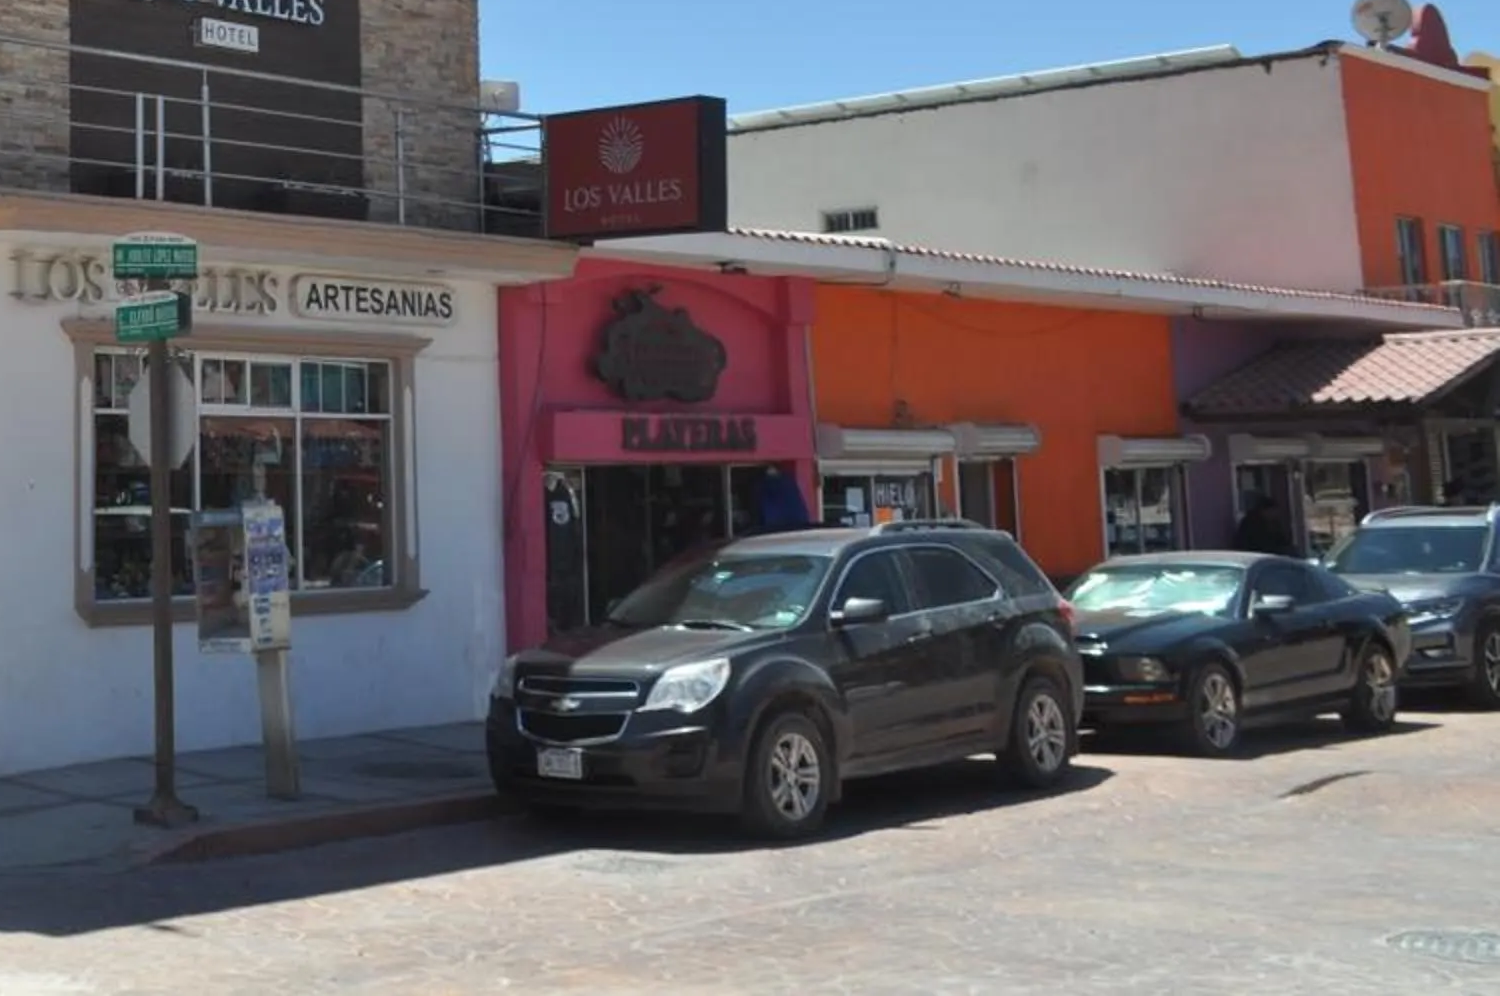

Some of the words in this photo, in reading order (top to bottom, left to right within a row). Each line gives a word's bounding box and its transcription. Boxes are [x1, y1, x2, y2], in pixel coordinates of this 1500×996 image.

[204, 24, 258, 48] HOTEL
[563, 186, 601, 213] LOS
[608, 178, 682, 205] VALLES
[8, 248, 105, 303] LOS
[306, 283, 453, 319] ARTESANIAS
[622, 415, 757, 451] PLAYERAS
